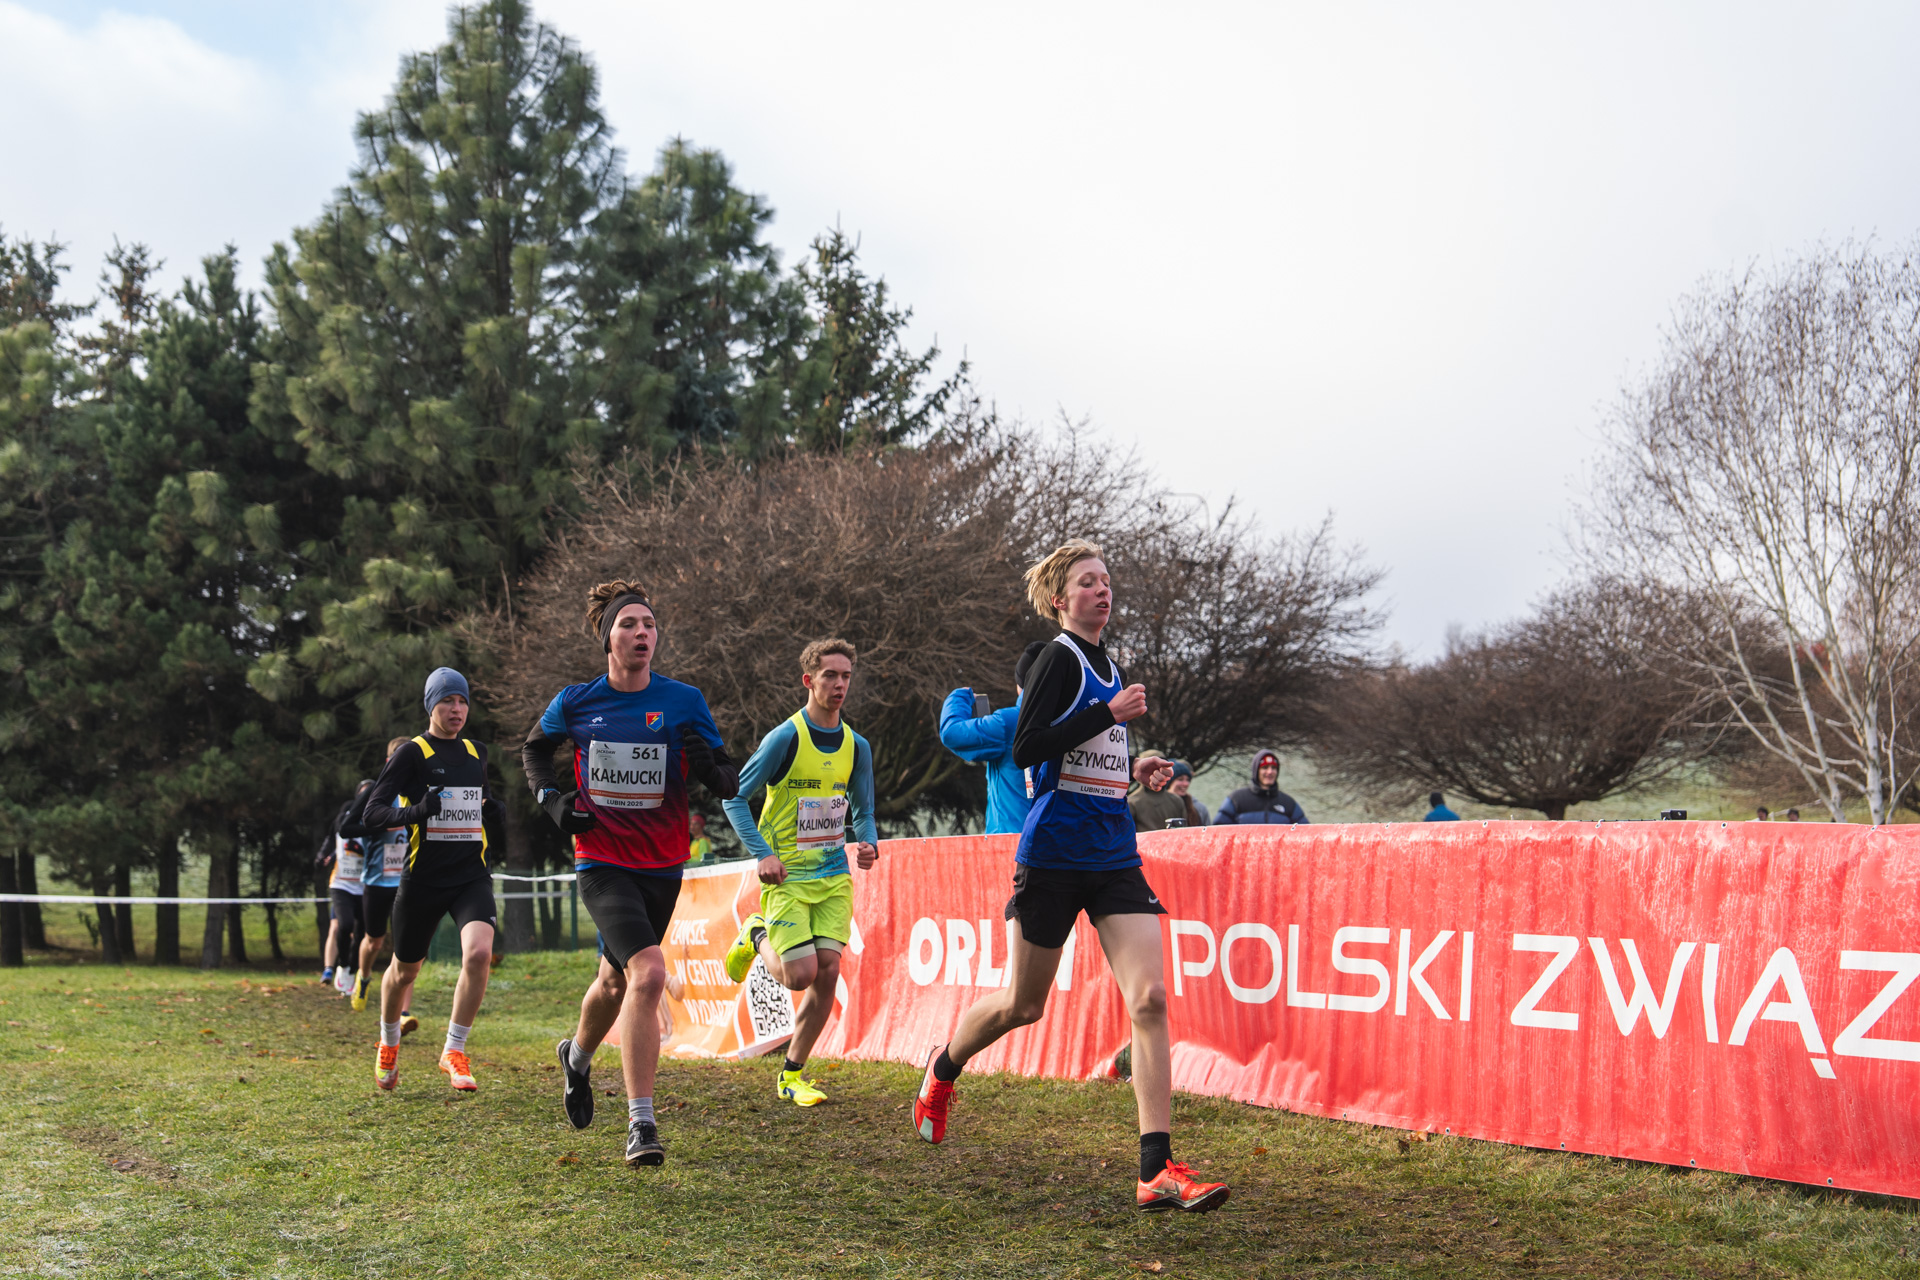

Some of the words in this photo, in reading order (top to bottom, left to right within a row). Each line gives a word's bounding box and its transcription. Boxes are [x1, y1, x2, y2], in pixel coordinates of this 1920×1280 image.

[1109, 729, 1125, 744] 604
[632, 747, 659, 760] 561
[1066, 750, 1127, 772] SZYMCZAK
[591, 768, 662, 785] KAŁMUCKI
[463, 790, 479, 800] 391
[1080, 785, 1100, 794] LUBIN
[1101, 788, 1116, 796] 2025
[607, 799, 626, 807] LUBIN
[831, 798, 845, 809] 384
[670, 919, 709, 945] ZAWSZE
[674, 959, 687, 985] W
[687, 959, 745, 987] CENTRU
[1170, 919, 1473, 1021] POLSKI
[1511, 934, 1920, 1079] ZWIĄZ
